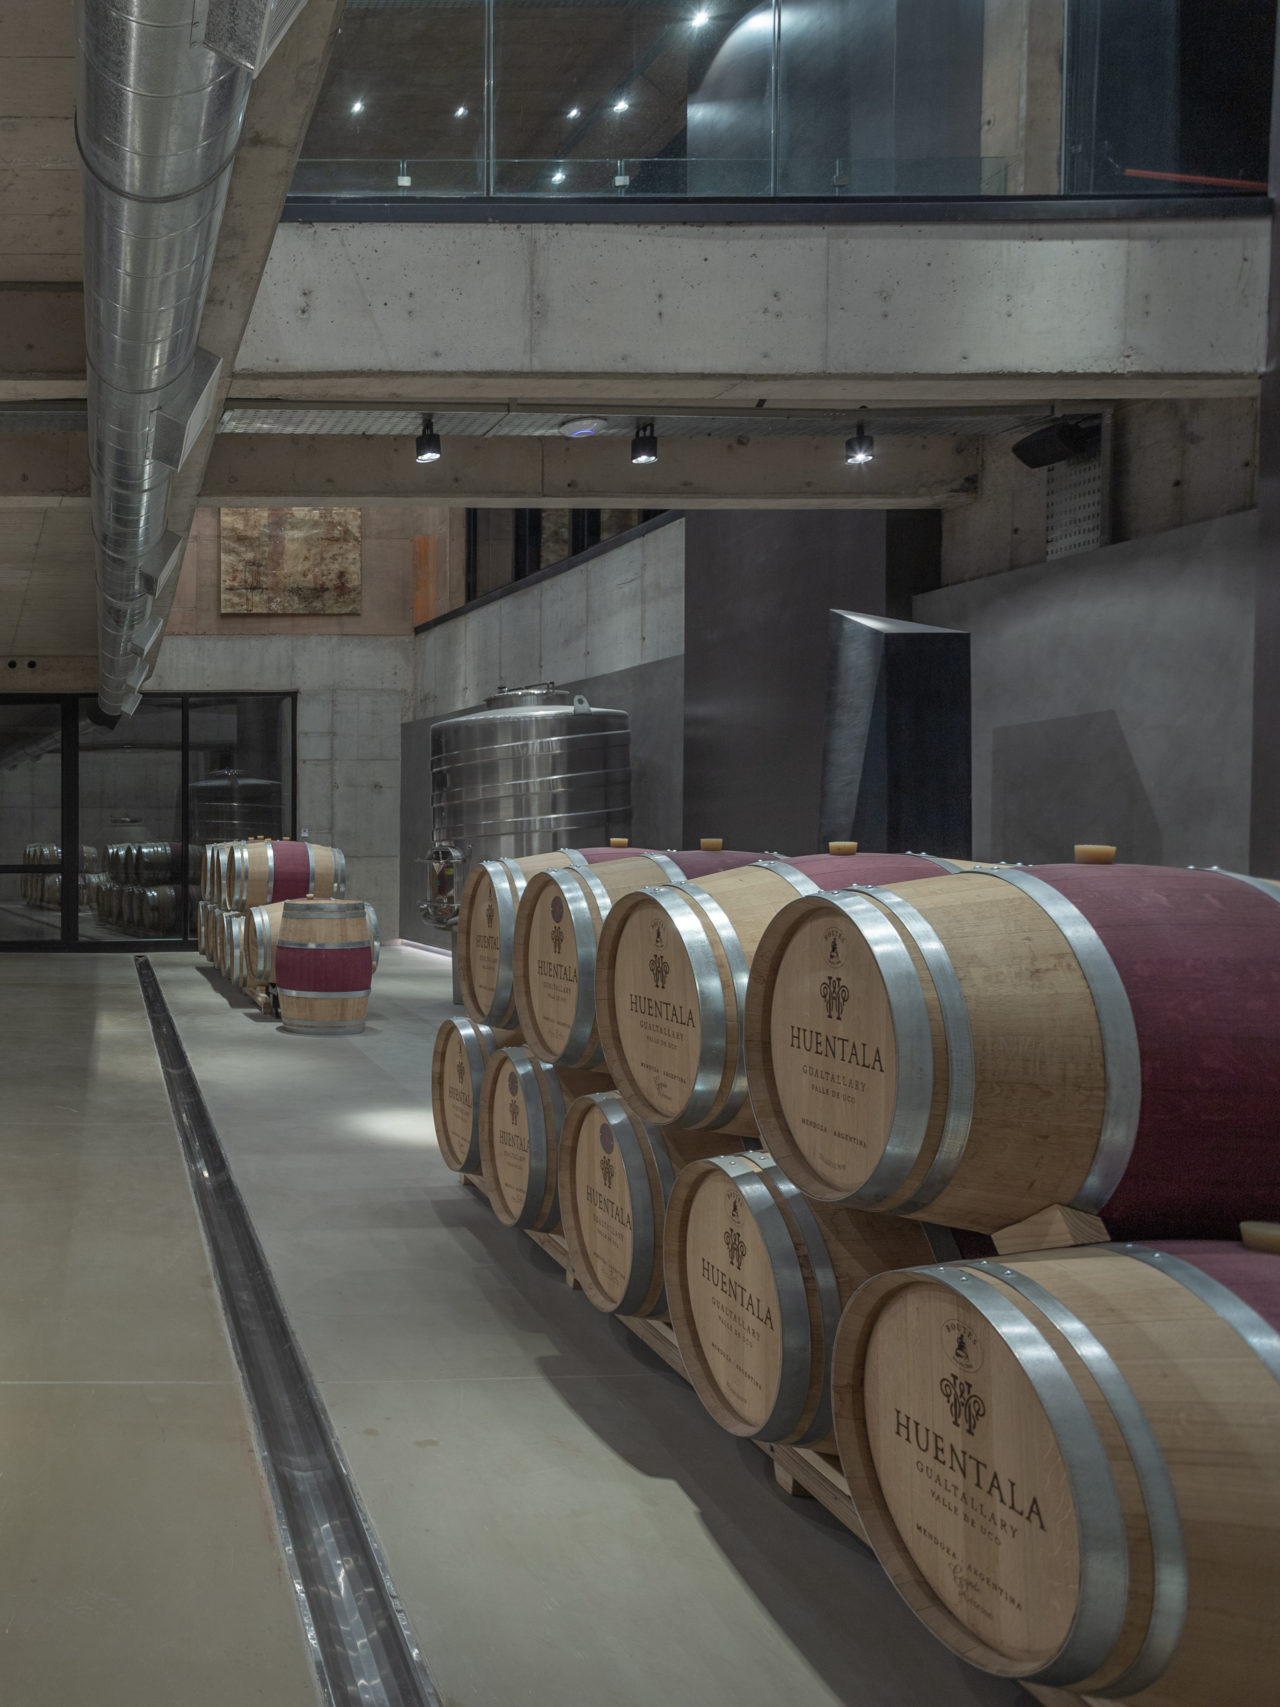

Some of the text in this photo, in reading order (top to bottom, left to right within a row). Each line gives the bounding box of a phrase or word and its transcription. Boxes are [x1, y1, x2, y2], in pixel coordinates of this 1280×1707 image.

[476, 934, 500, 950] HUENTAL
[537, 959, 578, 983] HUENTALA
[630, 994, 696, 1028] HUENTALA
[789, 1025, 885, 1073] HUENTALA
[801, 1064, 867, 1093] GUALTALLARY
[810, 1083, 830, 1098] VALLE
[833, 1130, 868, 1149] ARGENTINA
[586, 1184, 632, 1231] HUENTALA
[701, 1256, 774, 1332] HUENTALA
[711, 1296, 761, 1342] GUALTALLARY
[894, 1407, 1047, 1533] HUENTALA
[915, 1459, 1019, 1540] GUALTALLARY
[929, 1488, 1002, 1547] VALLE DE UCO
[915, 1522, 958, 1561] MENDOZA
[966, 1562, 1023, 1612] ARGENTINA
